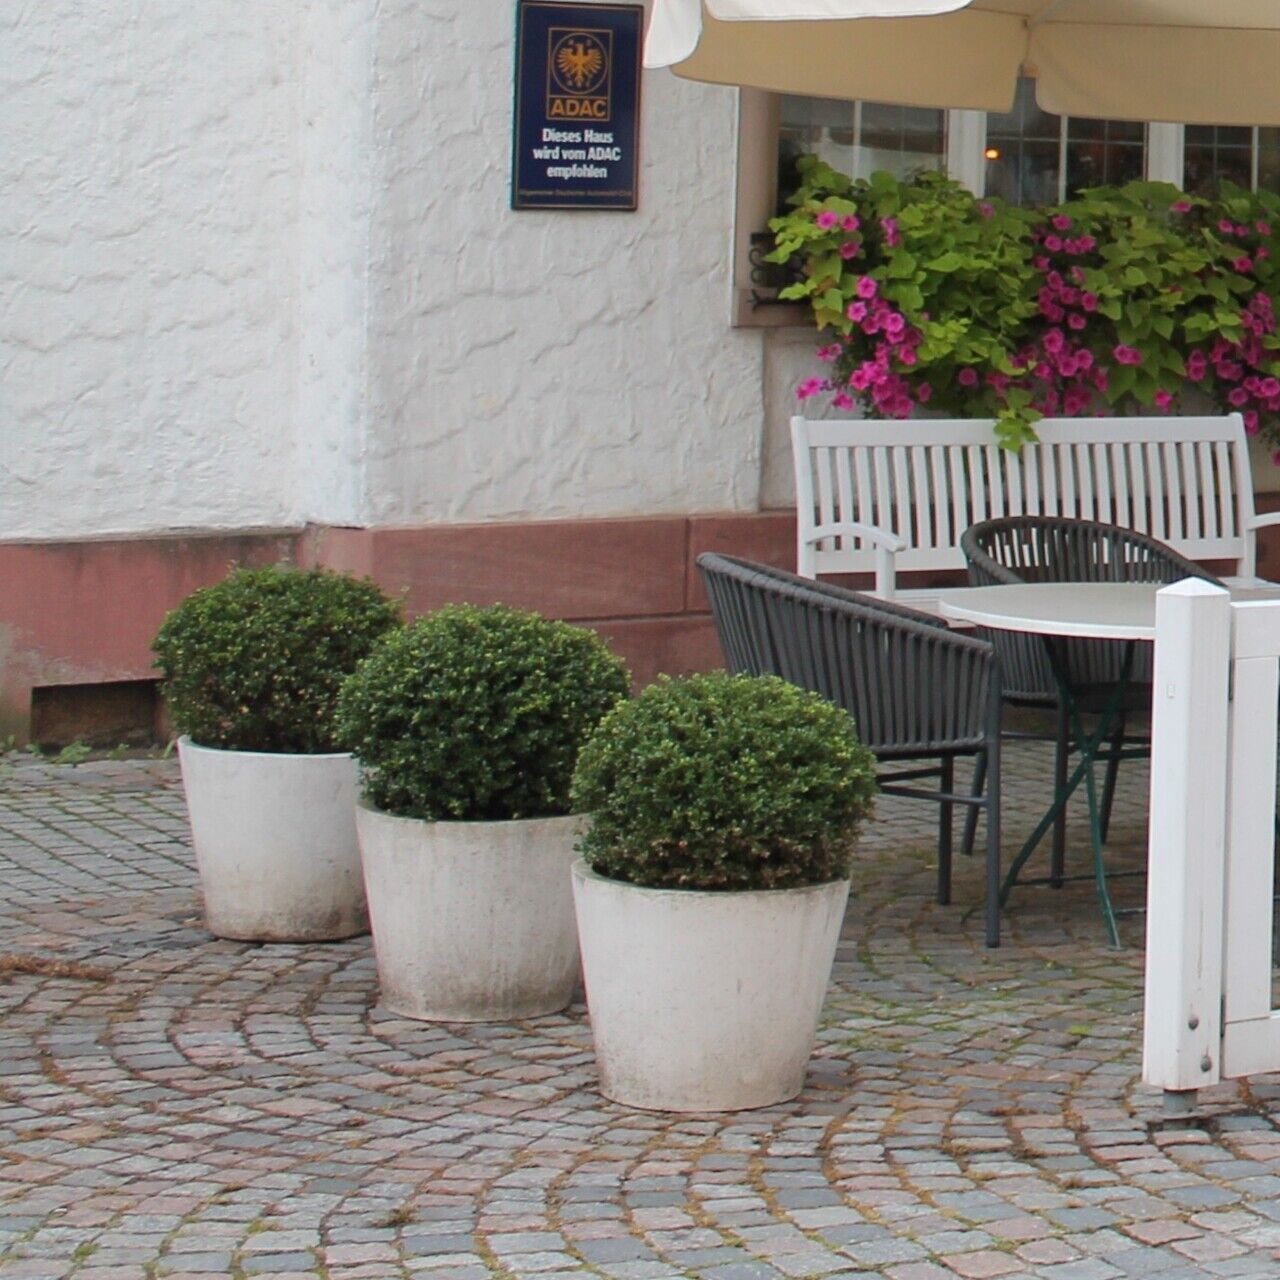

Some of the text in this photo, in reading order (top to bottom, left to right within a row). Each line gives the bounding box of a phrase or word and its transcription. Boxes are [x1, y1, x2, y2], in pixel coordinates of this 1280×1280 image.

[551, 99, 607, 117] ADAC
[542, 128, 613, 143] Dieses Haus
[533, 146, 621, 161] wird vom ADAC
[547, 165, 607, 180] empfohlen
